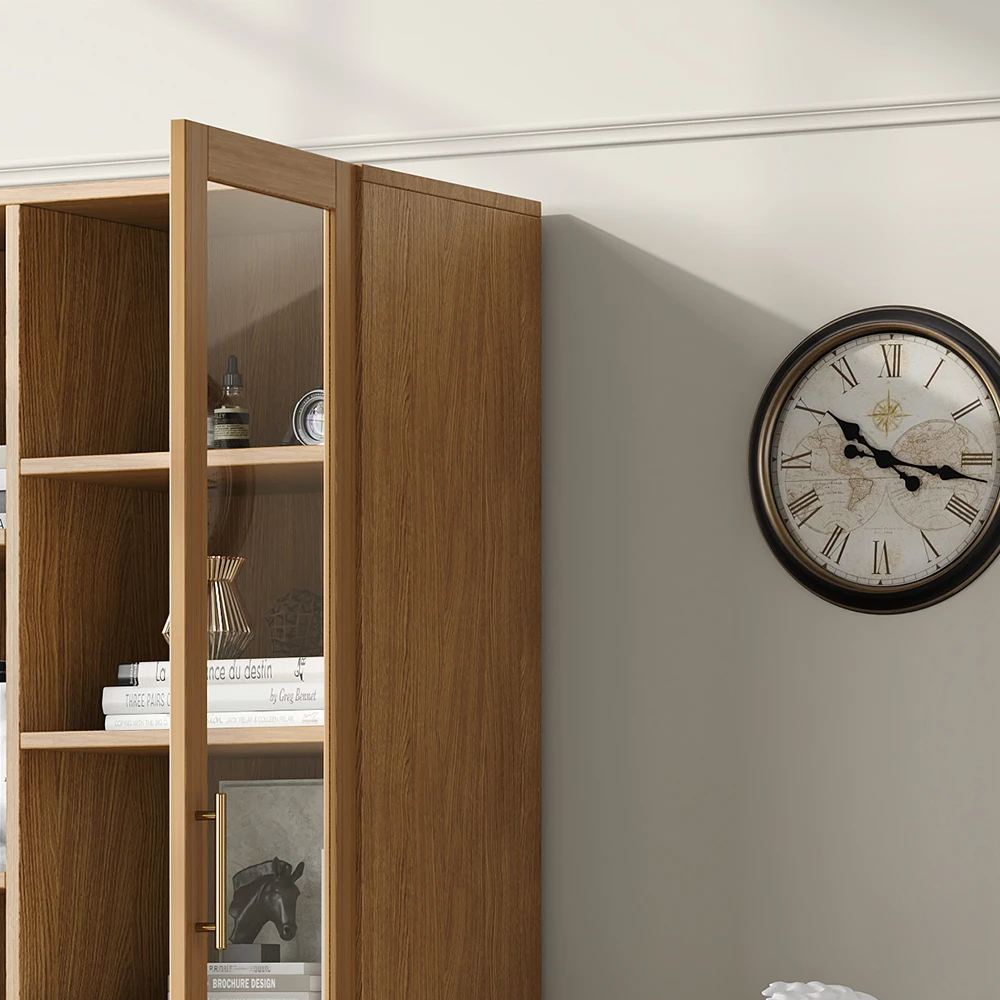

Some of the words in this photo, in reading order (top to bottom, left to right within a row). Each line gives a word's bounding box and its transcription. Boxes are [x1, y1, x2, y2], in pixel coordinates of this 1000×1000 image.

[829, 356, 860, 394] XI
[877, 344, 903, 378] XII
[923, 357, 945, 389] I
[794, 398, 826, 426] X
[951, 398, 983, 422] II
[781, 450, 812, 471] IX
[961, 451, 993, 467] III
[787, 488, 823, 529] VIII
[944, 493, 980, 527] IIII
[820, 524, 850, 565] VII
[872, 540, 891, 575] VI
[920, 529, 941, 563] V
[155, 662, 166, 682] La
[228, 659, 241, 680] du
[244, 658, 272, 680] destin
[125, 693, 145, 708] THREE
[146, 692, 164, 706] PAIRS
[270, 689, 278, 703] by
[278, 689, 294, 704] Greg
[295, 688, 316, 702] Bennet
[212, 978, 250, 989] BROCHURE
[250, 978, 276, 989] DESIGN
